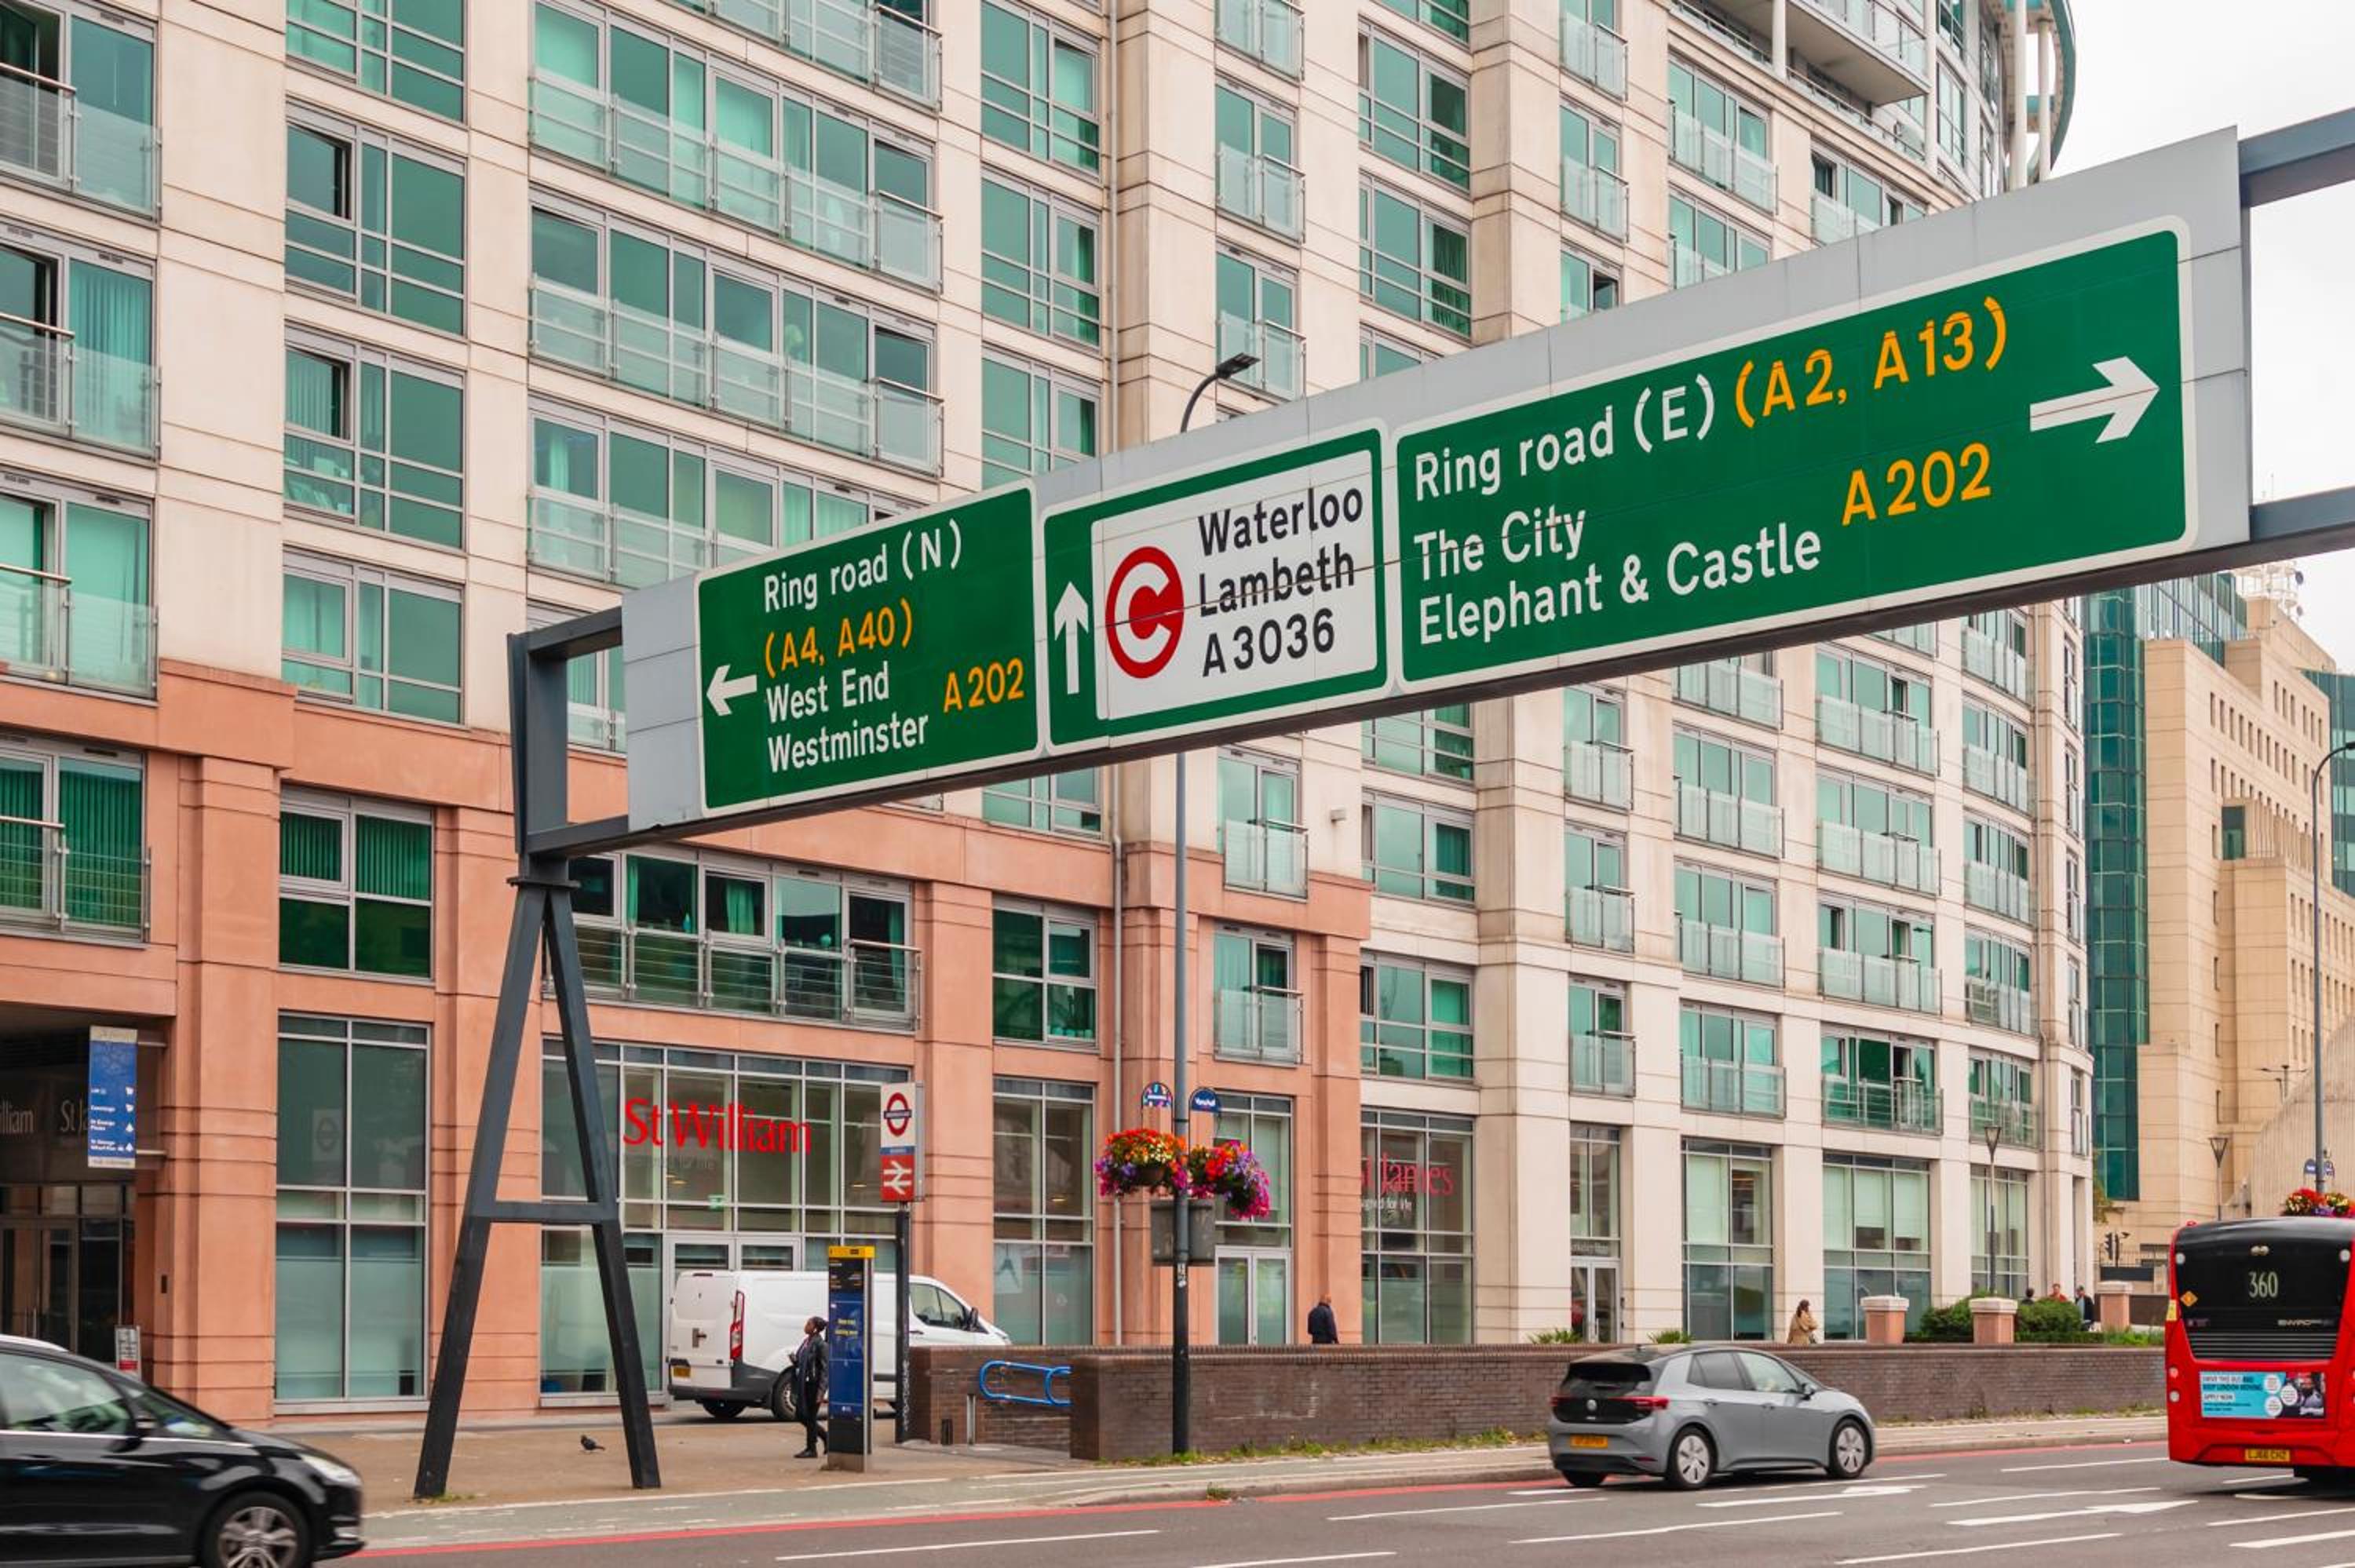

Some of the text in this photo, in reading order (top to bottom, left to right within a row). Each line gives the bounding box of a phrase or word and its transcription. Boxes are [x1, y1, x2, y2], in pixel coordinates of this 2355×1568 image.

[1415, 296, 2006, 501] Ring road (E) (A2, A13)
[1842, 442, 1991, 526] A202
[1197, 487, 1363, 556] Waterloo
[1414, 505, 1586, 581] The City
[764, 518, 962, 612] Ring road (N)
[1199, 542, 1354, 617] Lambeth
[1419, 522, 1821, 645] Elephant & Castle
[765, 597, 913, 679] (A4, A40)
[1202, 607, 1334, 678] A3036
[765, 660, 889, 723] West End
[943, 658, 1024, 713] A202
[767, 711, 929, 773] Westminster
[0, 1097, 34, 1134] illiam
[623, 1097, 812, 1154] St William
[1381, 1151, 1455, 1197] James
[2248, 1271, 2279, 1298] 360
